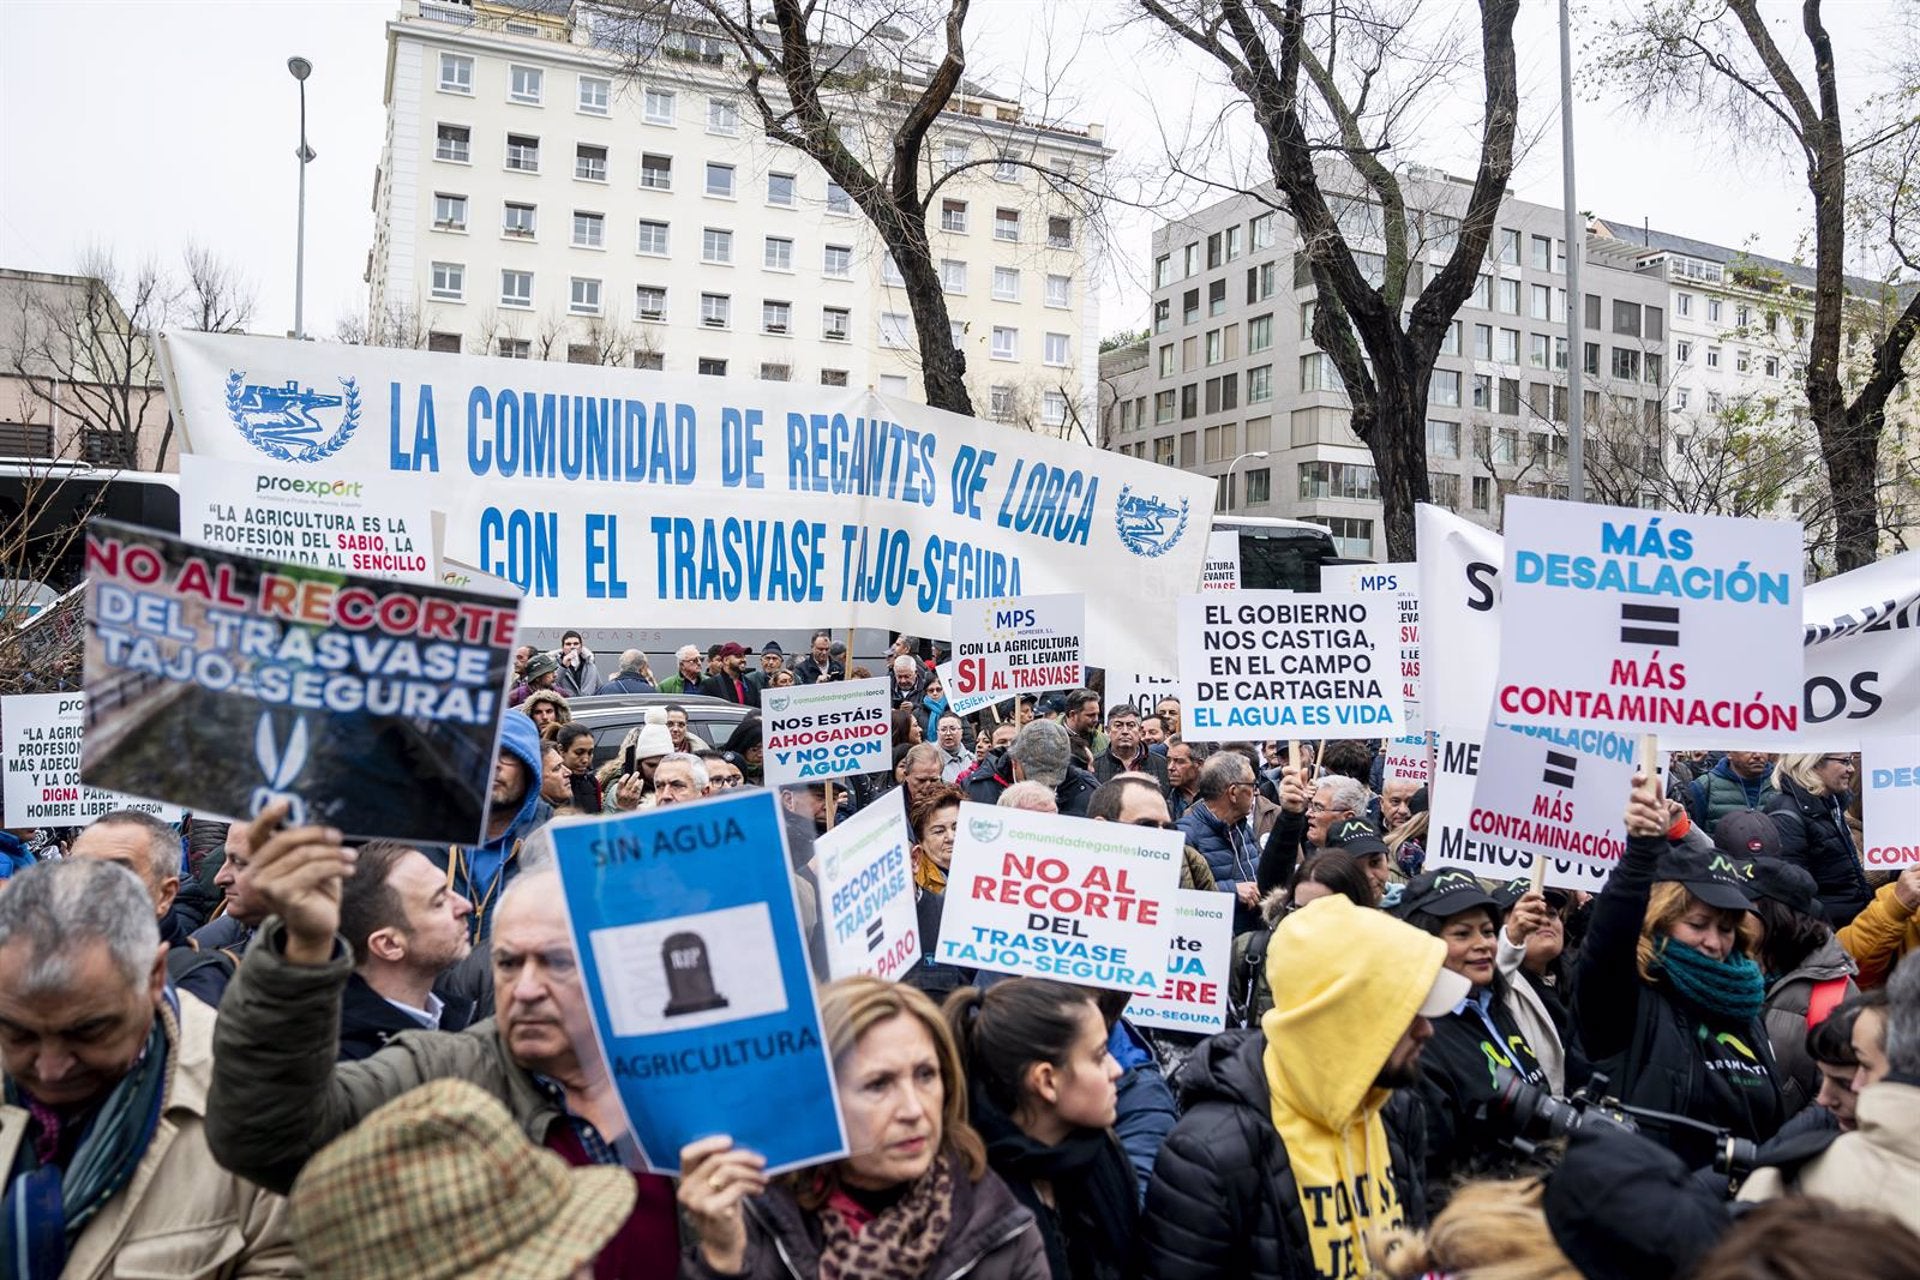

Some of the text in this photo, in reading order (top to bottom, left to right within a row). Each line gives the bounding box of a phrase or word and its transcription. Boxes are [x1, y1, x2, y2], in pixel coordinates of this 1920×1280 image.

[390, 382, 1099, 546] LA COMUNIDAD DE REGANTES DE LORCA
[256, 475, 363, 498] proexport
[245, 508, 356, 531] AGRICULTURA
[363, 517, 381, 533] ES
[388, 518, 407, 534] LA
[204, 523, 294, 547] PROFESIÓN
[303, 532, 331, 549] DEL
[338, 534, 388, 554] SABIO,
[395, 537, 414, 552] LA
[1601, 517, 1694, 561] MÁS
[353, 554, 426, 571] SENCILLO
[480, 506, 1022, 615] CON EL TRASVASE TAJO-SEGURA
[86, 540, 161, 585] NO
[175, 562, 245, 608] AL
[262, 574, 517, 646] RECORTE
[1361, 575, 1397, 591] MPS
[1515, 550, 1790, 605] DESALACIÓN
[996, 609, 1036, 629] MPS
[1205, 603, 1367, 624] EL GOBIERNO
[99, 585, 195, 641] DEL
[209, 611, 490, 685] TRASVASE
[960, 636, 1079, 656] CON LA AGRICULTURA
[1204, 629, 1375, 651] NOS CASTIGA,
[1009, 650, 1078, 666] DEL LEVANTE
[1210, 654, 1371, 676] EN EL CAMPO
[1610, 650, 1686, 691] MÁS
[99, 628, 492, 725] TAJO-SEGURA!
[958, 658, 986, 693] SI
[992, 671, 1008, 690] AL
[1012, 665, 1079, 688] TRASVASE
[1197, 679, 1382, 702] DE CARTAGENA
[772, 707, 883, 731] NOS ESTÁIS
[1193, 704, 1393, 727] EL AGUA ES VIDA
[1500, 685, 1797, 731] CONTAMINACIÓN
[768, 723, 888, 749] AHOGANDO
[9, 755, 35, 772] MÁS
[776, 740, 881, 765] Y NO CON
[798, 757, 861, 778] AGUA
[1387, 755, 1416, 767] MÁS
[32, 774, 39, 786] Y
[45, 773, 59, 785] LA
[42, 788, 78, 801] DIGNA
[27, 803, 76, 818] HOMBRE
[1532, 791, 1574, 823] MÁS
[590, 817, 746, 867] SIN AGUA
[1009, 830, 1170, 861] comunidadreganteslorca
[1470, 808, 1625, 862] CONTAMINACIÓN
[832, 844, 903, 918] RECORTES
[1002, 853, 1136, 895] NO AL
[835, 870, 906, 944] TRASVASE
[972, 875, 1159, 926] RECORTE
[1027, 913, 1088, 938] DEL
[878, 930, 915, 977] PARO
[972, 926, 1127, 965] TRASVASE
[942, 940, 1157, 989] TAJO-SEGURA
[613, 1026, 818, 1080] AGRICULTURA
